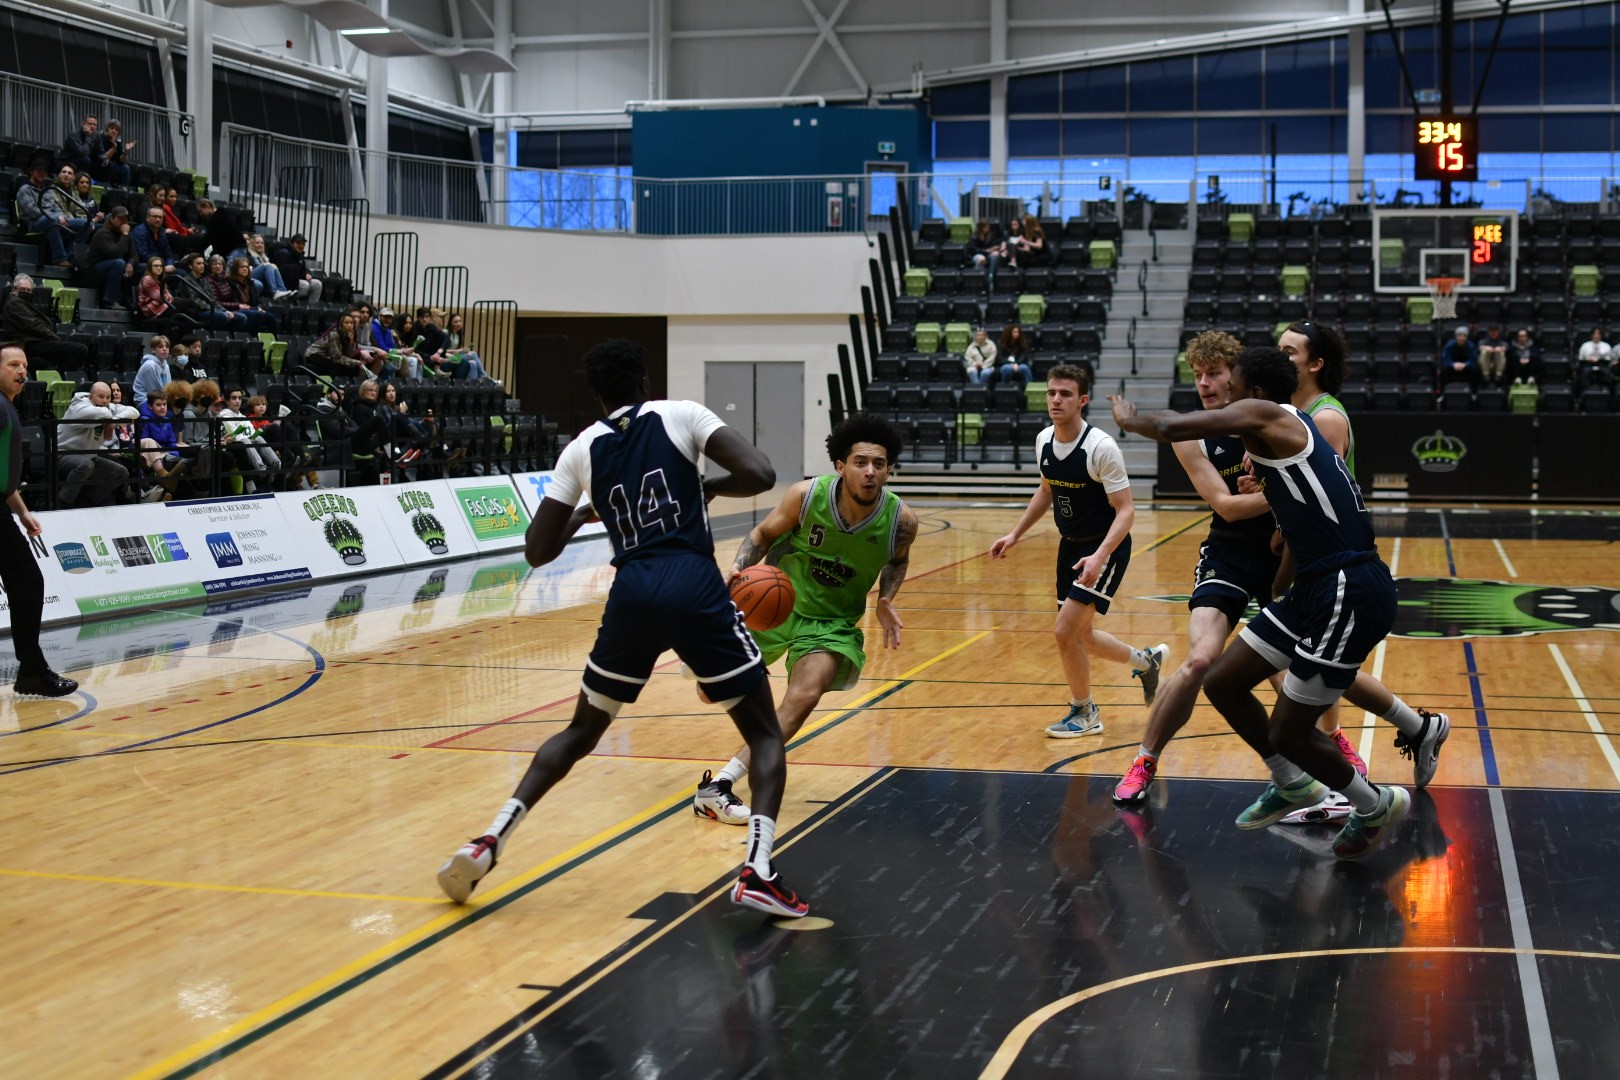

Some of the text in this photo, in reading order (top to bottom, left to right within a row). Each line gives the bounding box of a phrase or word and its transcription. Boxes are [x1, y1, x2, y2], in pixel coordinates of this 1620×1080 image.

[181, 119, 189, 135] G
[1418, 121, 1462, 144] 33.4
[1438, 142, 1464, 171] 15
[1047, 478, 1087, 489] ERCREST
[303, 493, 358, 521] QUEENS
[397, 490, 435, 514] KINGS
[608, 468, 681, 550] 14
[1057, 495, 1074, 518] 5
[490, 517, 509, 529] PLUS
[236, 529, 268, 540] JOHNSTON
[807, 523, 827, 548] 5
[118, 546, 149, 557] BOULEVARD
[210, 541, 238, 561] JMM
[242, 543, 260, 552] MING
[248, 554, 278, 565] MANNING
